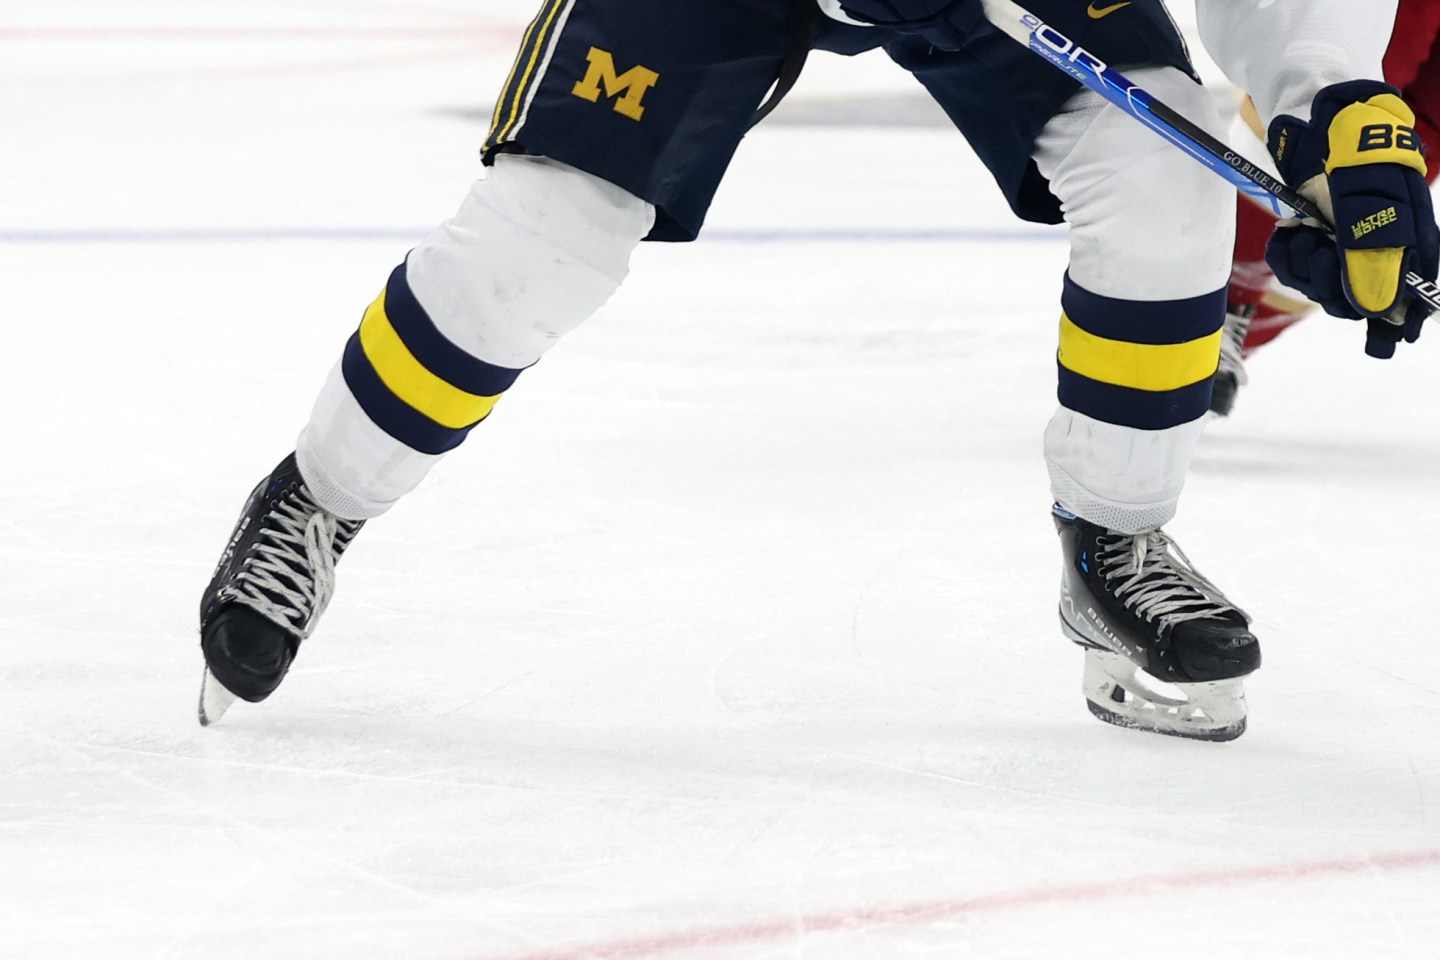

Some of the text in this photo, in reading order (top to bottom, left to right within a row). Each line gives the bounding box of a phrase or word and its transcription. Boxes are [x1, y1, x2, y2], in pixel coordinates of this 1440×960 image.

[571, 46, 660, 121] M
[1223, 151, 1242, 166] GO
[1241, 162, 1270, 185] BLUE
